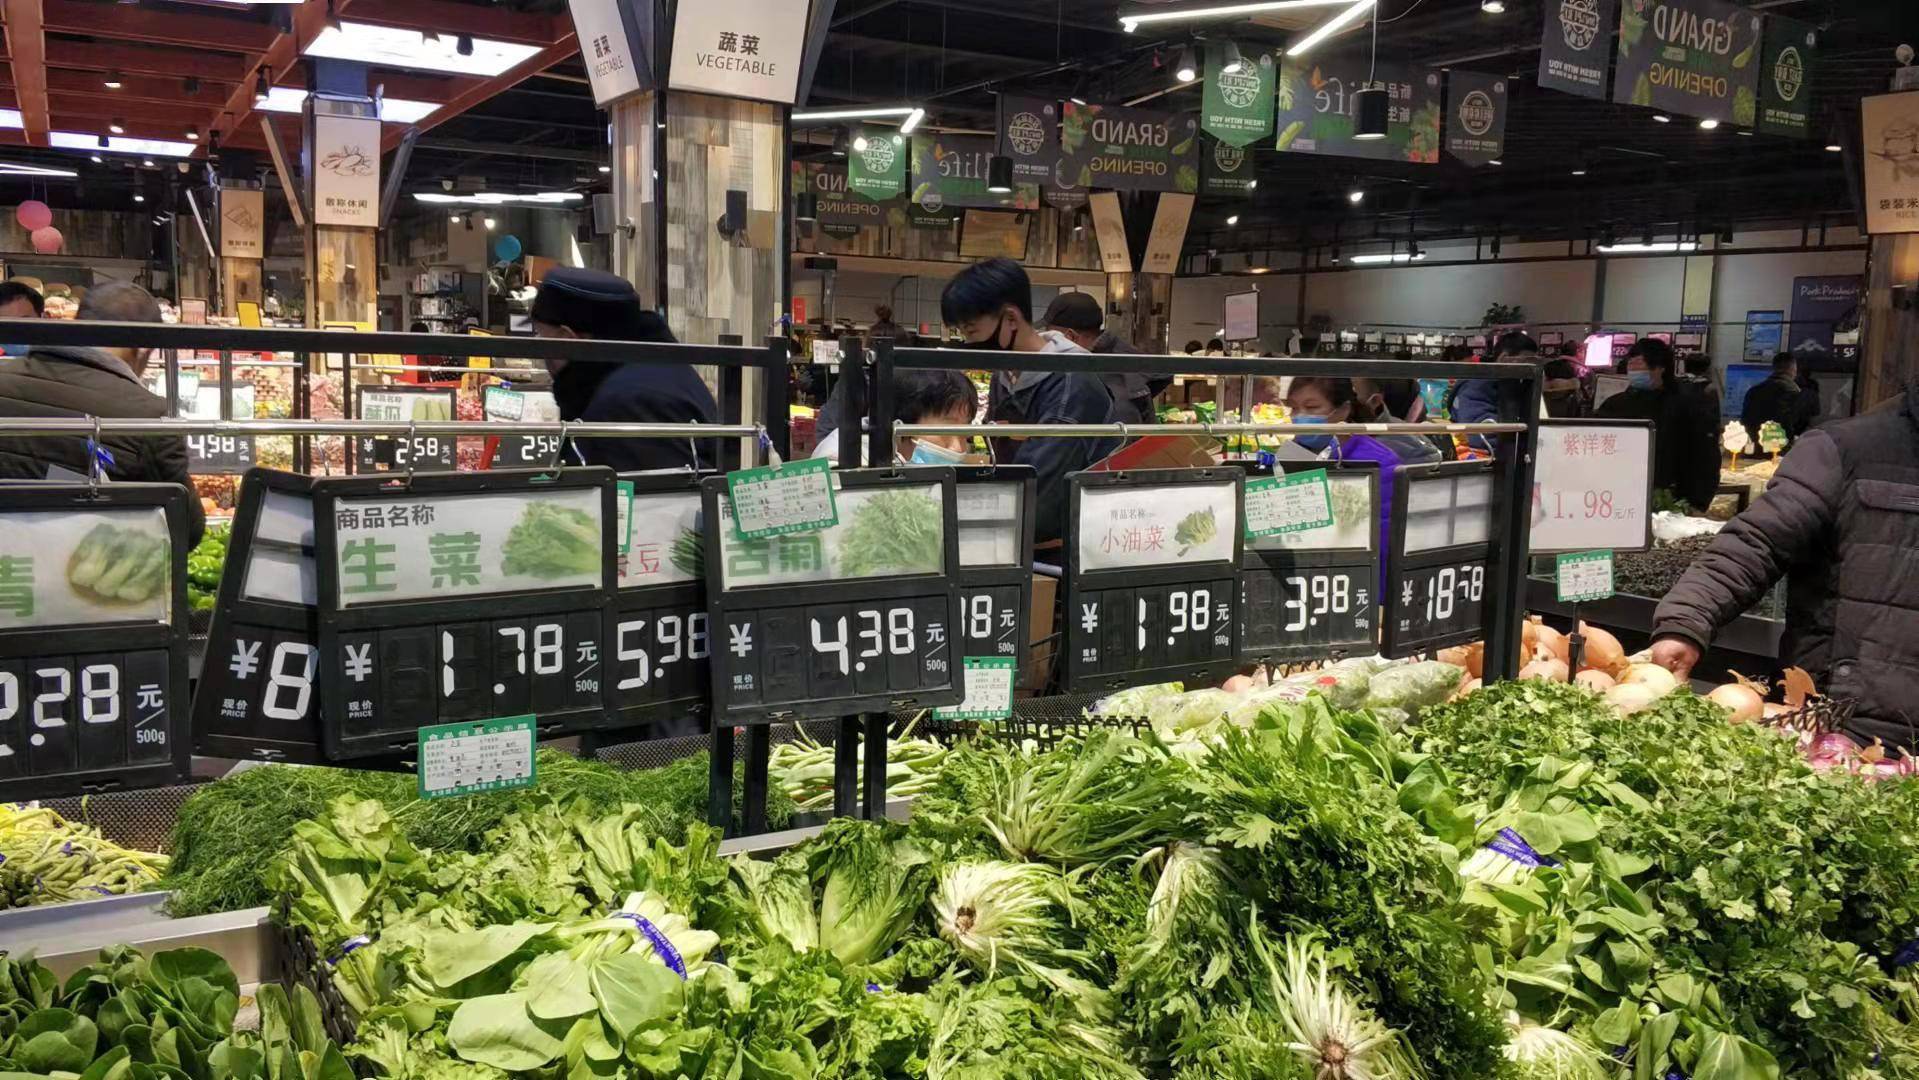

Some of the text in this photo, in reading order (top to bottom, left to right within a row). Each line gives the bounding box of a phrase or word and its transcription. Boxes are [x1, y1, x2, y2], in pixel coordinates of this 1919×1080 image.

[718, 31, 760, 56] 蔬菜
[696, 53, 777, 76] VEGETABLE
[1562, 432, 1617, 456] 紫洋葱
[1553, 489, 1614, 520] 1.98
[336, 504, 435, 530] 商品名称
[1100, 525, 1166, 554] 小油菜
[341, 531, 482, 595] 生菜
[1216, 603, 1230, 621] 元
[1284, 575, 1350, 632] 3.98
[1000, 608, 1015, 627] 元
[1138, 589, 1210, 651] 1.98
[810, 607, 915, 677] 4.38
[926, 623, 945, 644] 元
[576, 641, 598, 663] 元
[617, 611, 711, 690] 5.98
[998, 642, 1015, 654] 500g
[442, 623, 563, 697] 1.78
[926, 659, 947, 673] 500g
[575, 678, 599, 693] 500g
[733, 674, 753, 684] 现价
[136, 683, 164, 710] 元
[222, 698, 249, 711] 现价
[348, 700, 373, 711] 现价
[220, 709, 247, 719] PRICE
[348, 709, 373, 718] PRICE
[136, 728, 166, 745] 500g
